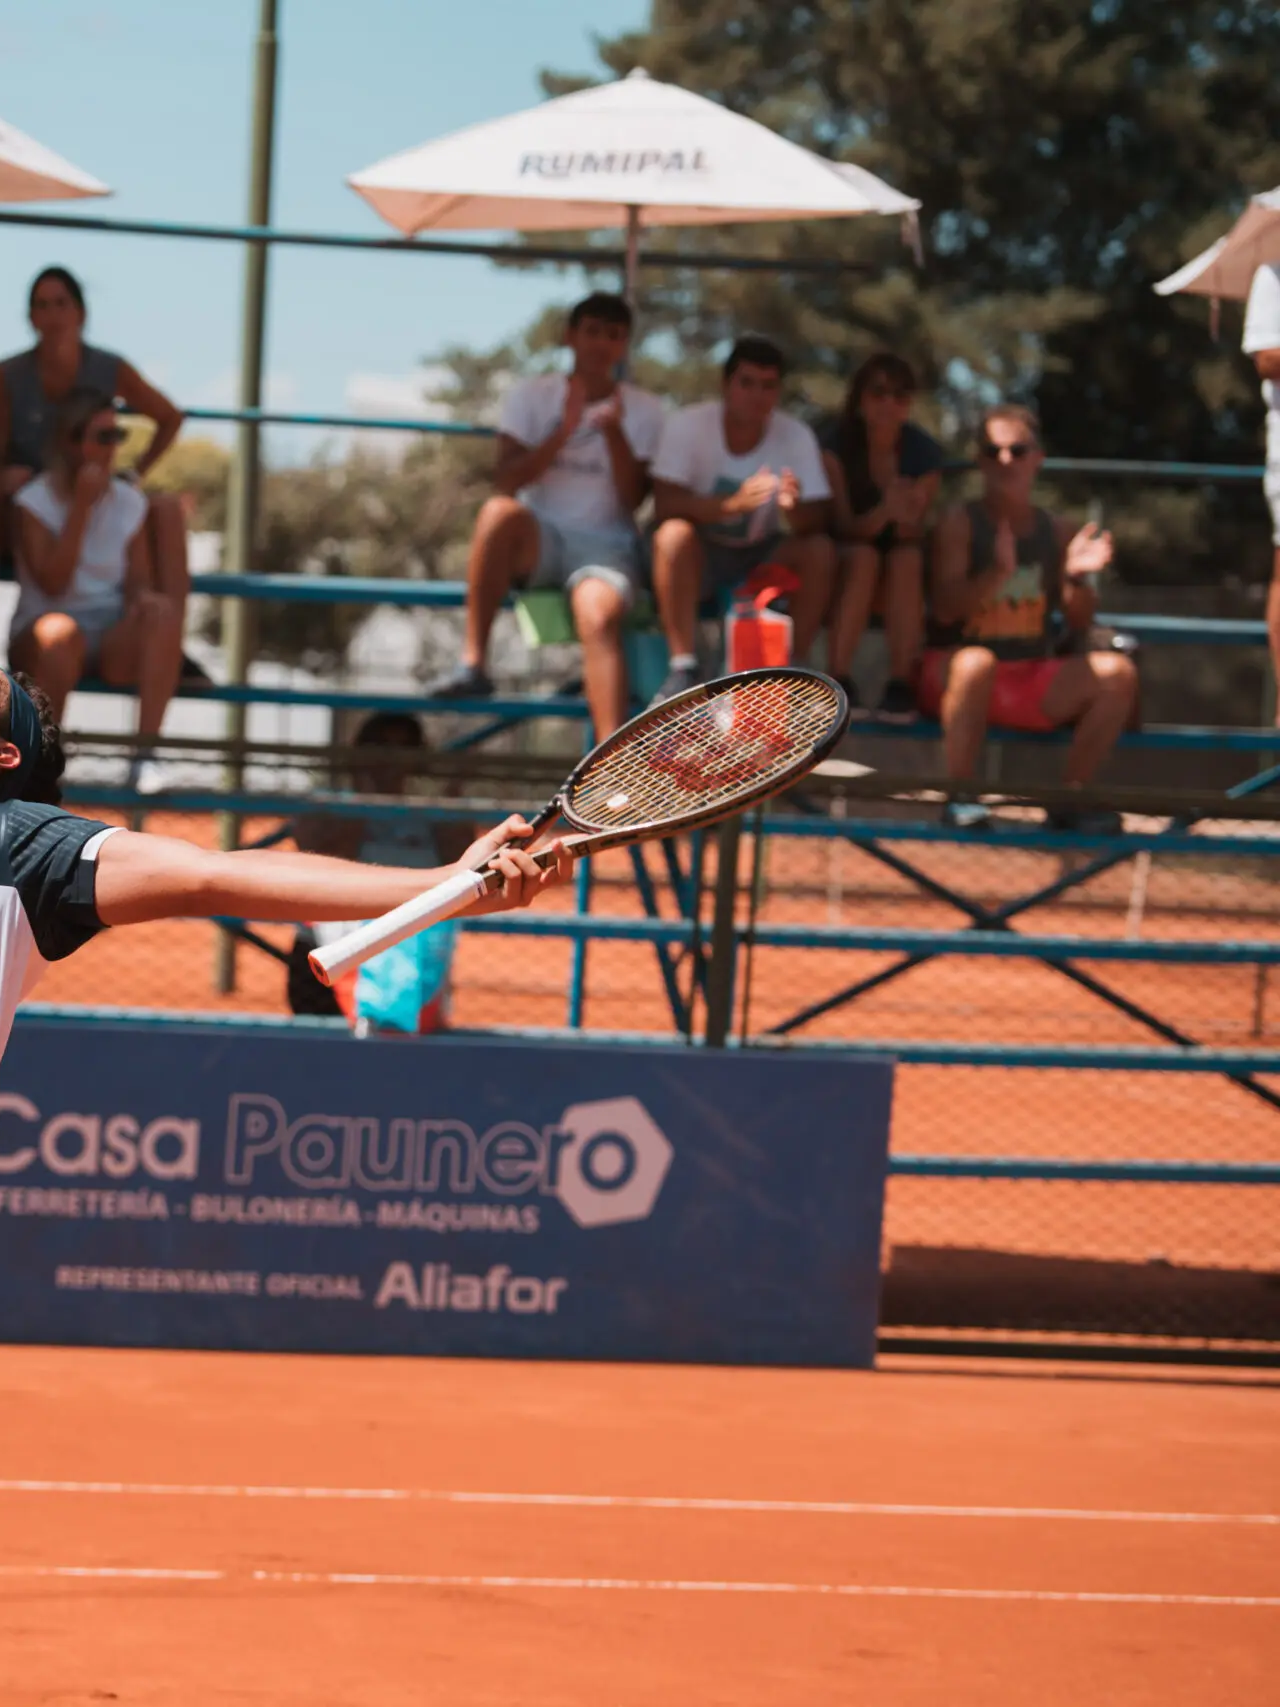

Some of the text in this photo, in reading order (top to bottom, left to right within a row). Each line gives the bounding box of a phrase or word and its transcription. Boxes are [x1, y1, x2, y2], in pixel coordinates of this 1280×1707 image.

[521, 147, 709, 177] RUMIPAL
[224, 1092, 638, 1197] Paunero
[190, 1193, 360, 1227] BULONERÍA
[377, 1197, 540, 1232] MÁQUINAS
[55, 1260, 568, 1314] REPRESENTANTE OFICIAL Aliafor
